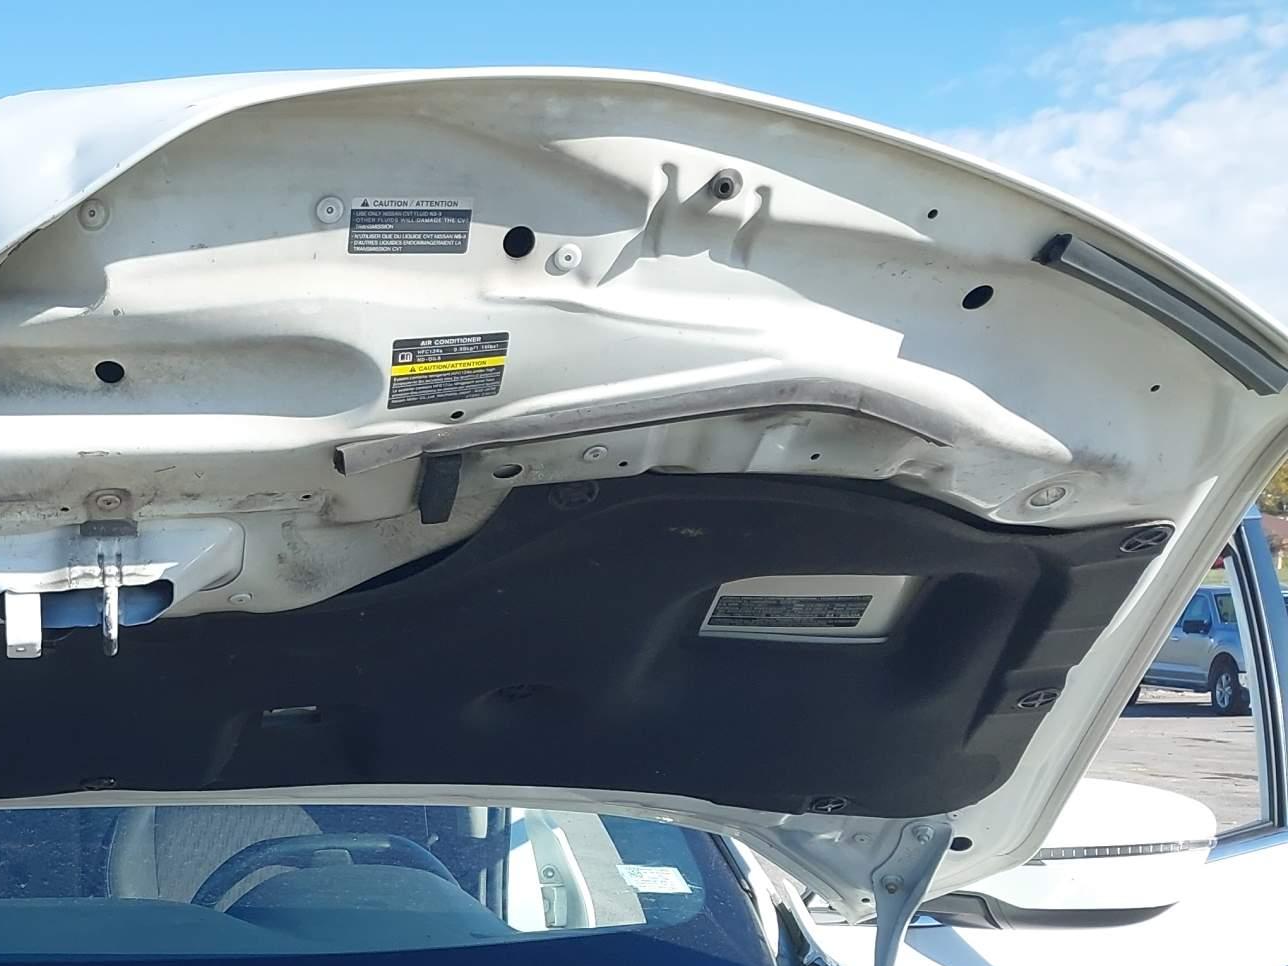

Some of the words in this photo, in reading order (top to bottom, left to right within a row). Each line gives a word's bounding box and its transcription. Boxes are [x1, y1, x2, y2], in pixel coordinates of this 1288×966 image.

[420, 338, 432, 346] AIR
[434, 336, 482, 345] CONDITIONER
[418, 360, 487, 371] CAUTION/ATTENTION
